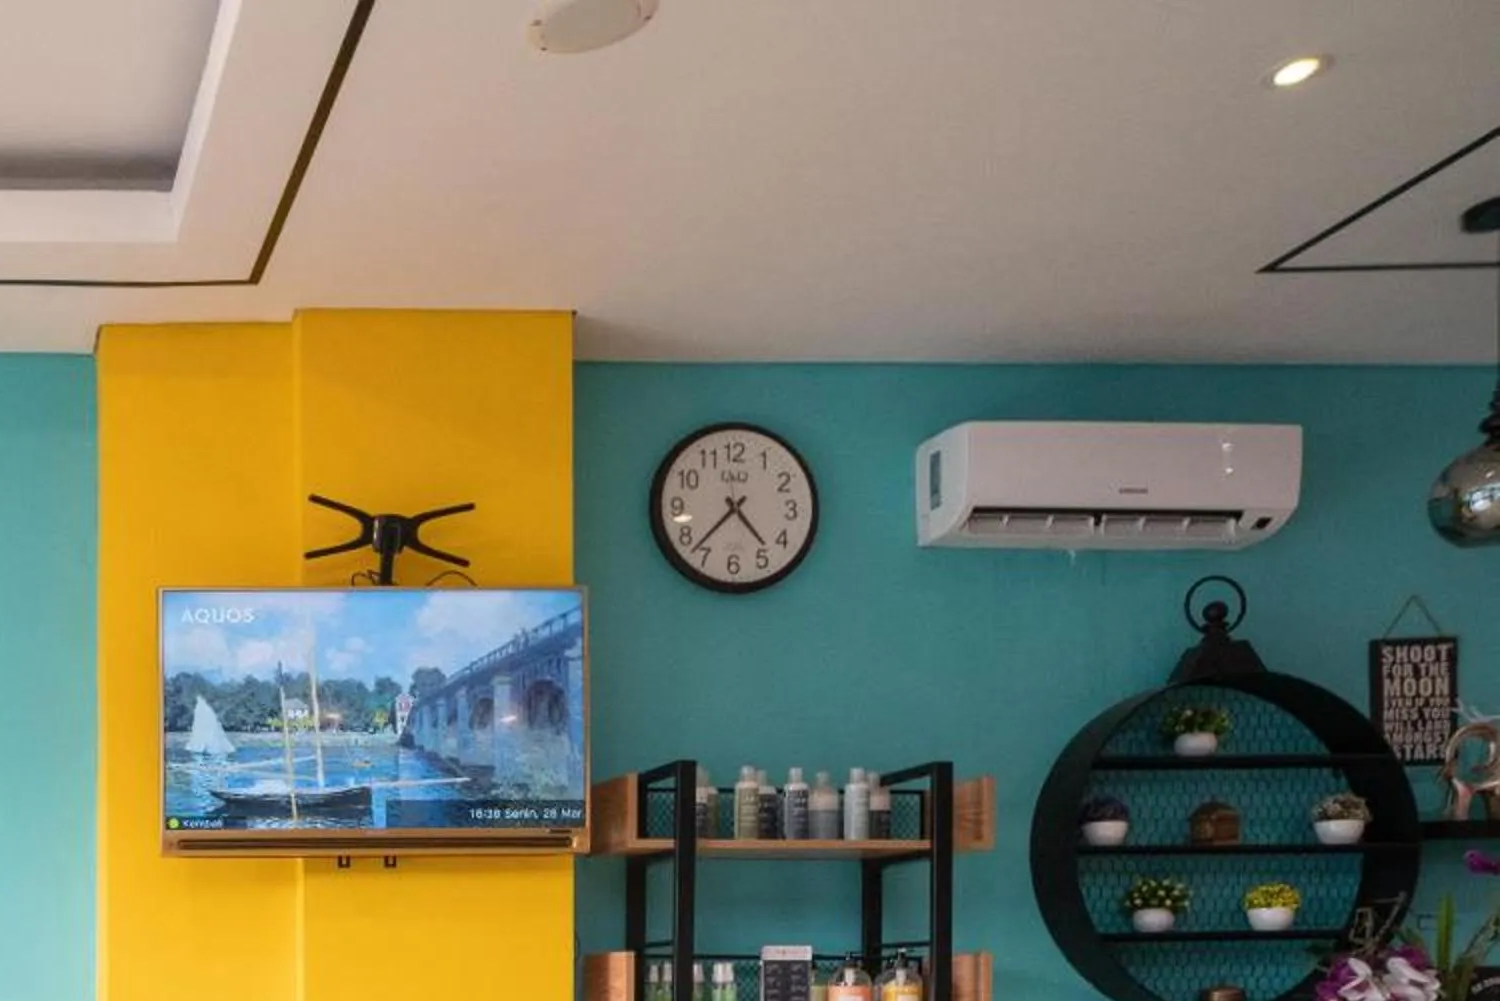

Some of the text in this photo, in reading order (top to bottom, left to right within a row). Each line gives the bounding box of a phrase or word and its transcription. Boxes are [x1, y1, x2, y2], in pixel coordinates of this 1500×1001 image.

[700, 448, 717, 469] 11
[723, 441, 746, 463] 12
[760, 451, 768, 470] 1
[678, 469, 699, 490] 10
[776, 472, 791, 493] 2
[670, 496, 684, 516] 9
[784, 500, 798, 521] 3
[678, 526, 693, 546] 8
[775, 529, 789, 549] 4
[699, 547, 712, 568] 7
[726, 554, 741, 575] 6
[756, 548, 769, 570] 5
[181, 606, 255, 624] AQUOS
[1381, 644, 1453, 663] SHOOT
[1382, 662, 1450, 677] FOR THE
[1383, 677, 1450, 697] MOON
[1384, 707, 1450, 722] MISS YOU
[1384, 720, 1451, 733] WILL LAND
[560, 807, 582, 819] Mar
